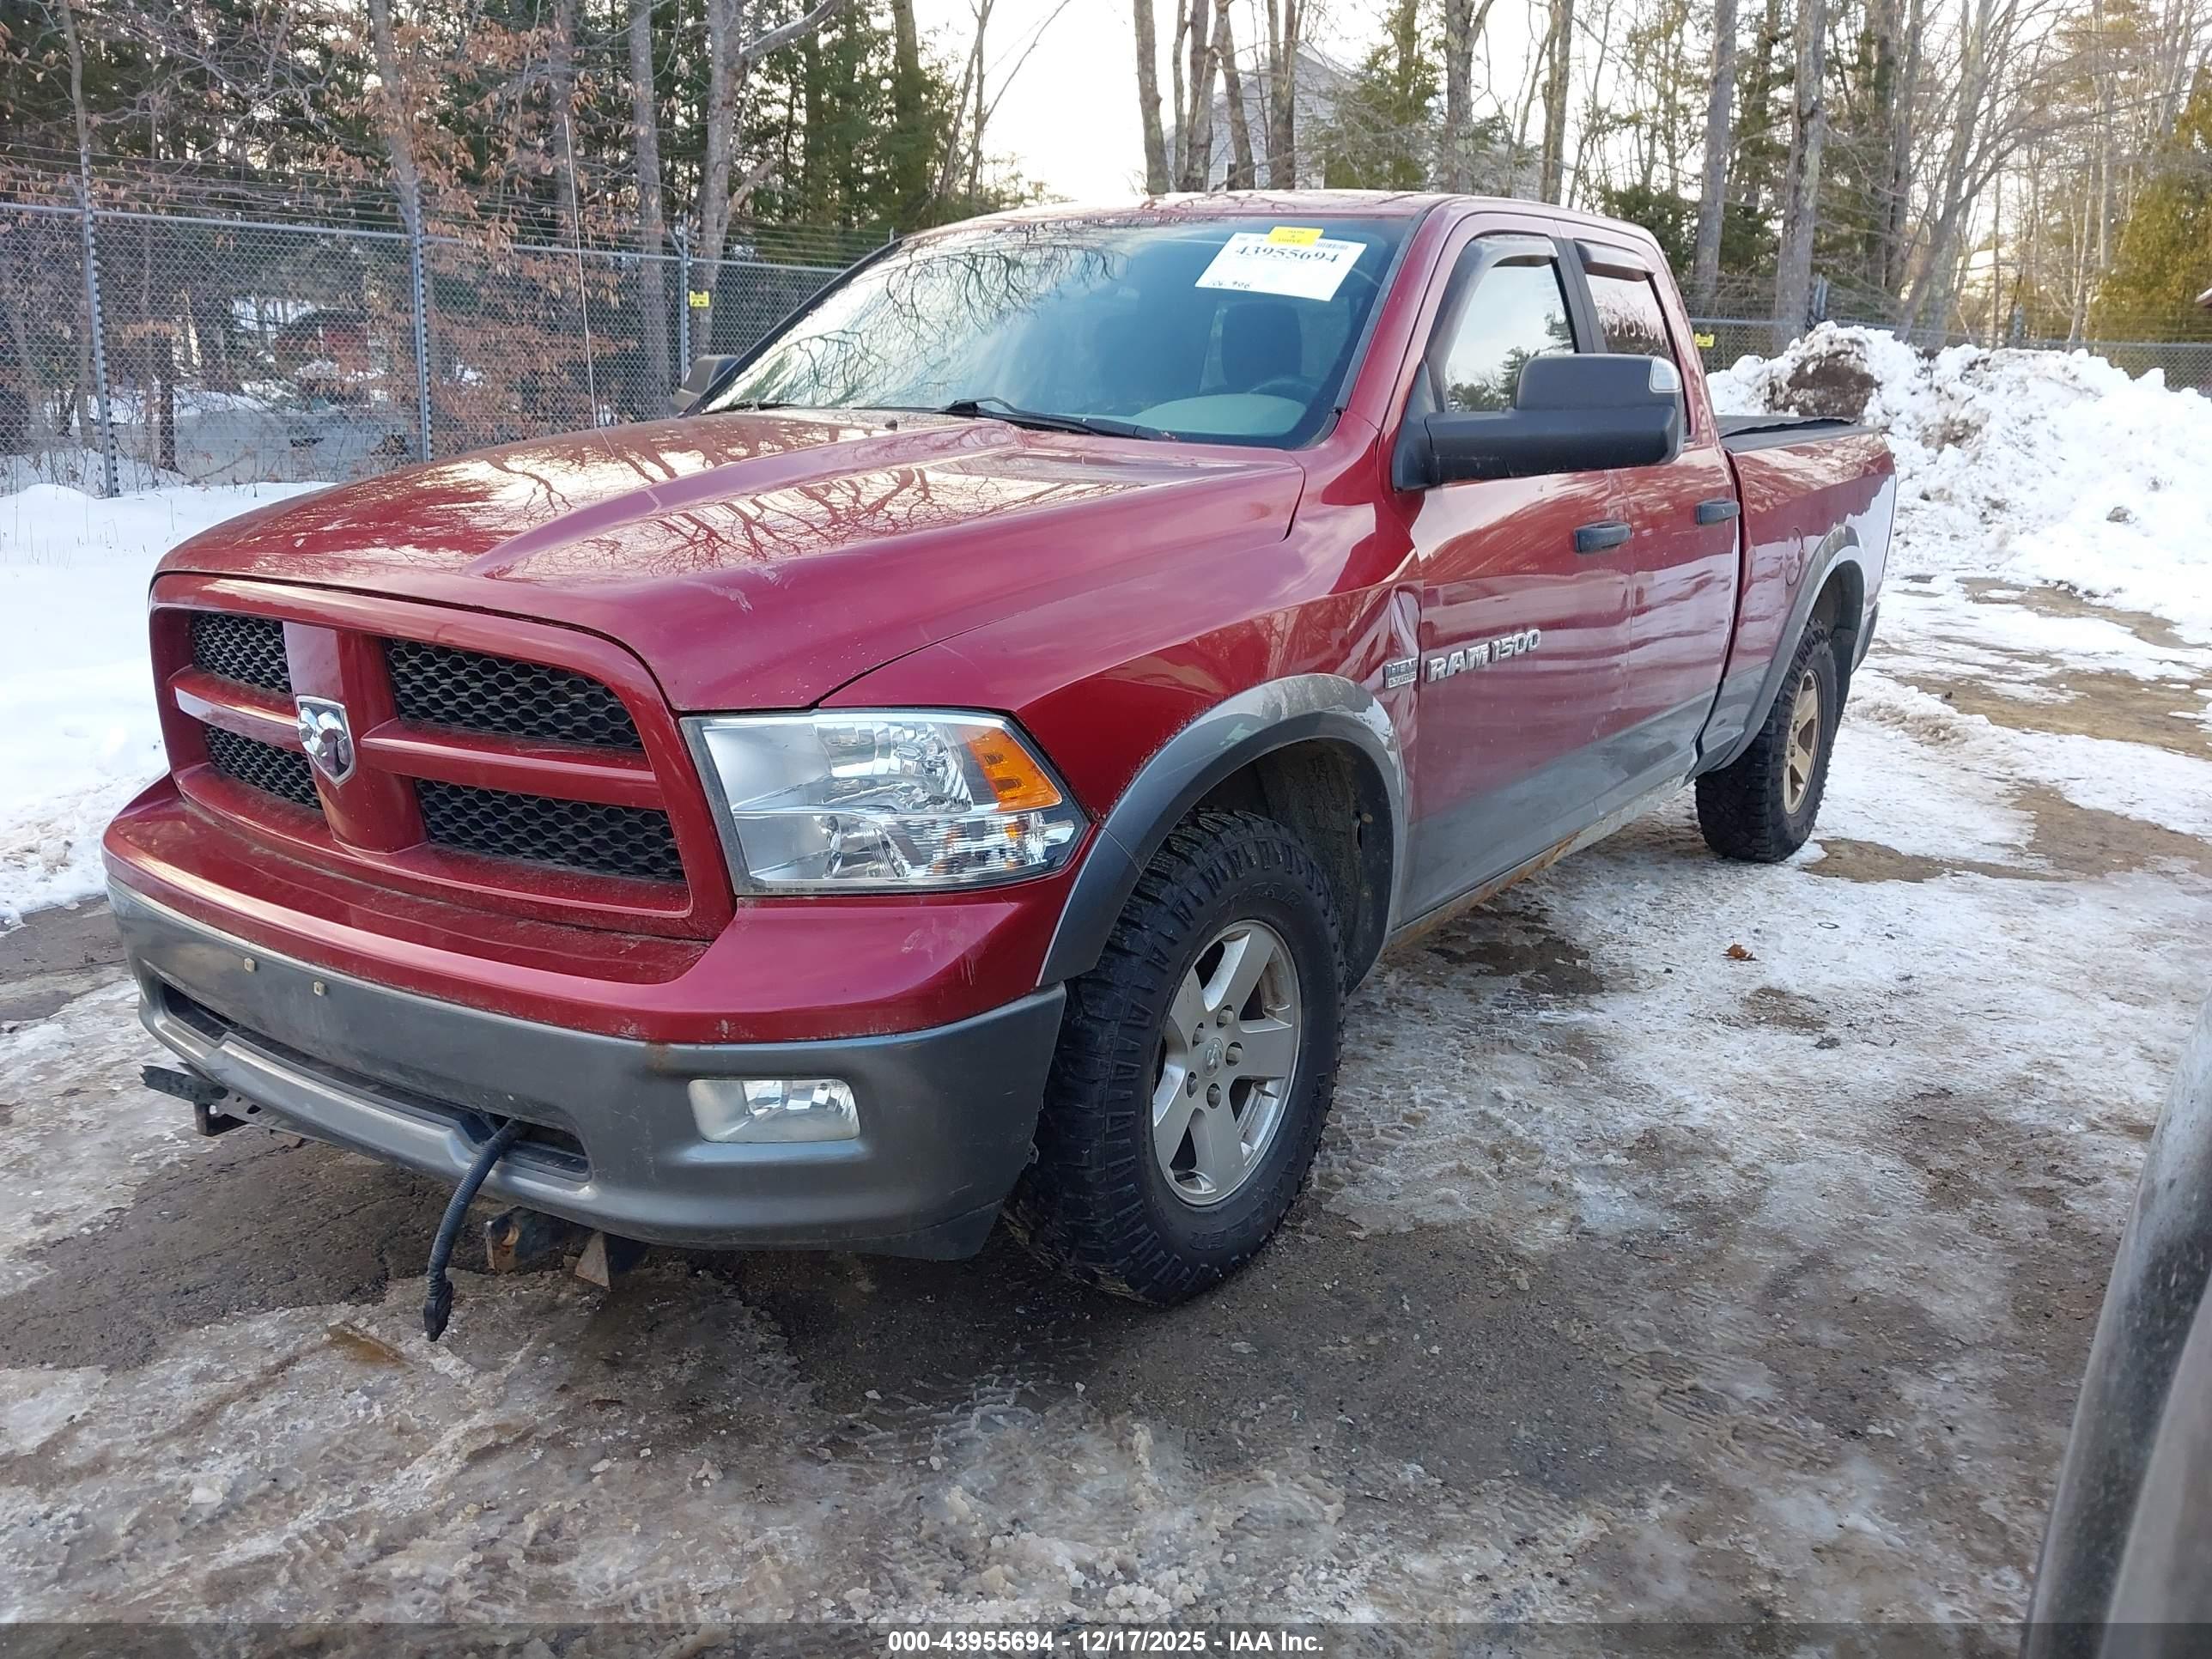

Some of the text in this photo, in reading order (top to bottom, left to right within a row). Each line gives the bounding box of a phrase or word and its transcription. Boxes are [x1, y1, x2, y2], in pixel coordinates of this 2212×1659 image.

[1235, 245, 1340, 264] 43955694
[1426, 628, 1542, 683] RAM 1500
[1387, 658, 1417, 678] HEMI
